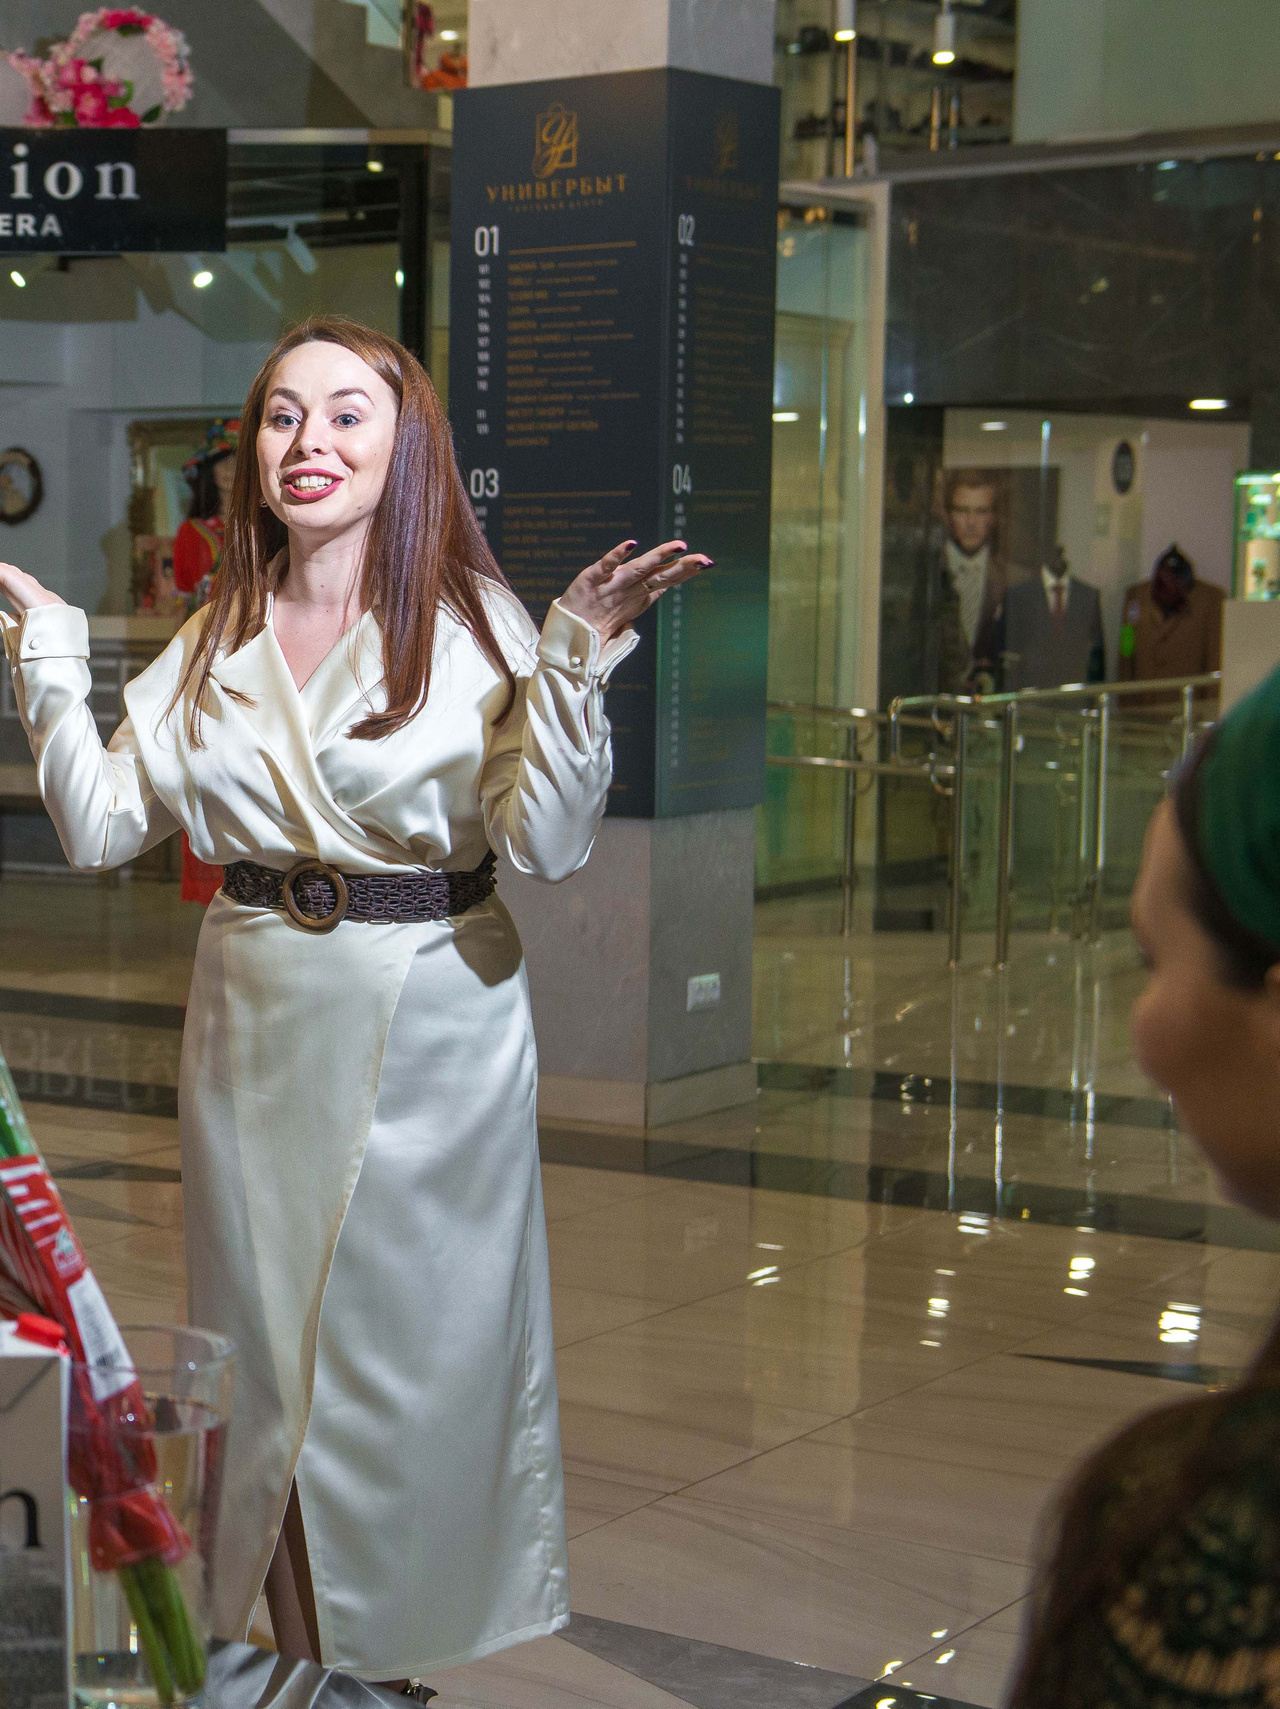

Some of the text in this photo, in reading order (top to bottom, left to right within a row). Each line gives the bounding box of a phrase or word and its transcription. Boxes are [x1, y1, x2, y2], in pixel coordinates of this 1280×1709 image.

[486, 174, 627, 203] УНИВЕРБЫТ
[474, 225, 500, 257] 01
[678, 214, 696, 247] 02
[470, 468, 500, 499] 03
[672, 464, 693, 495] 04
